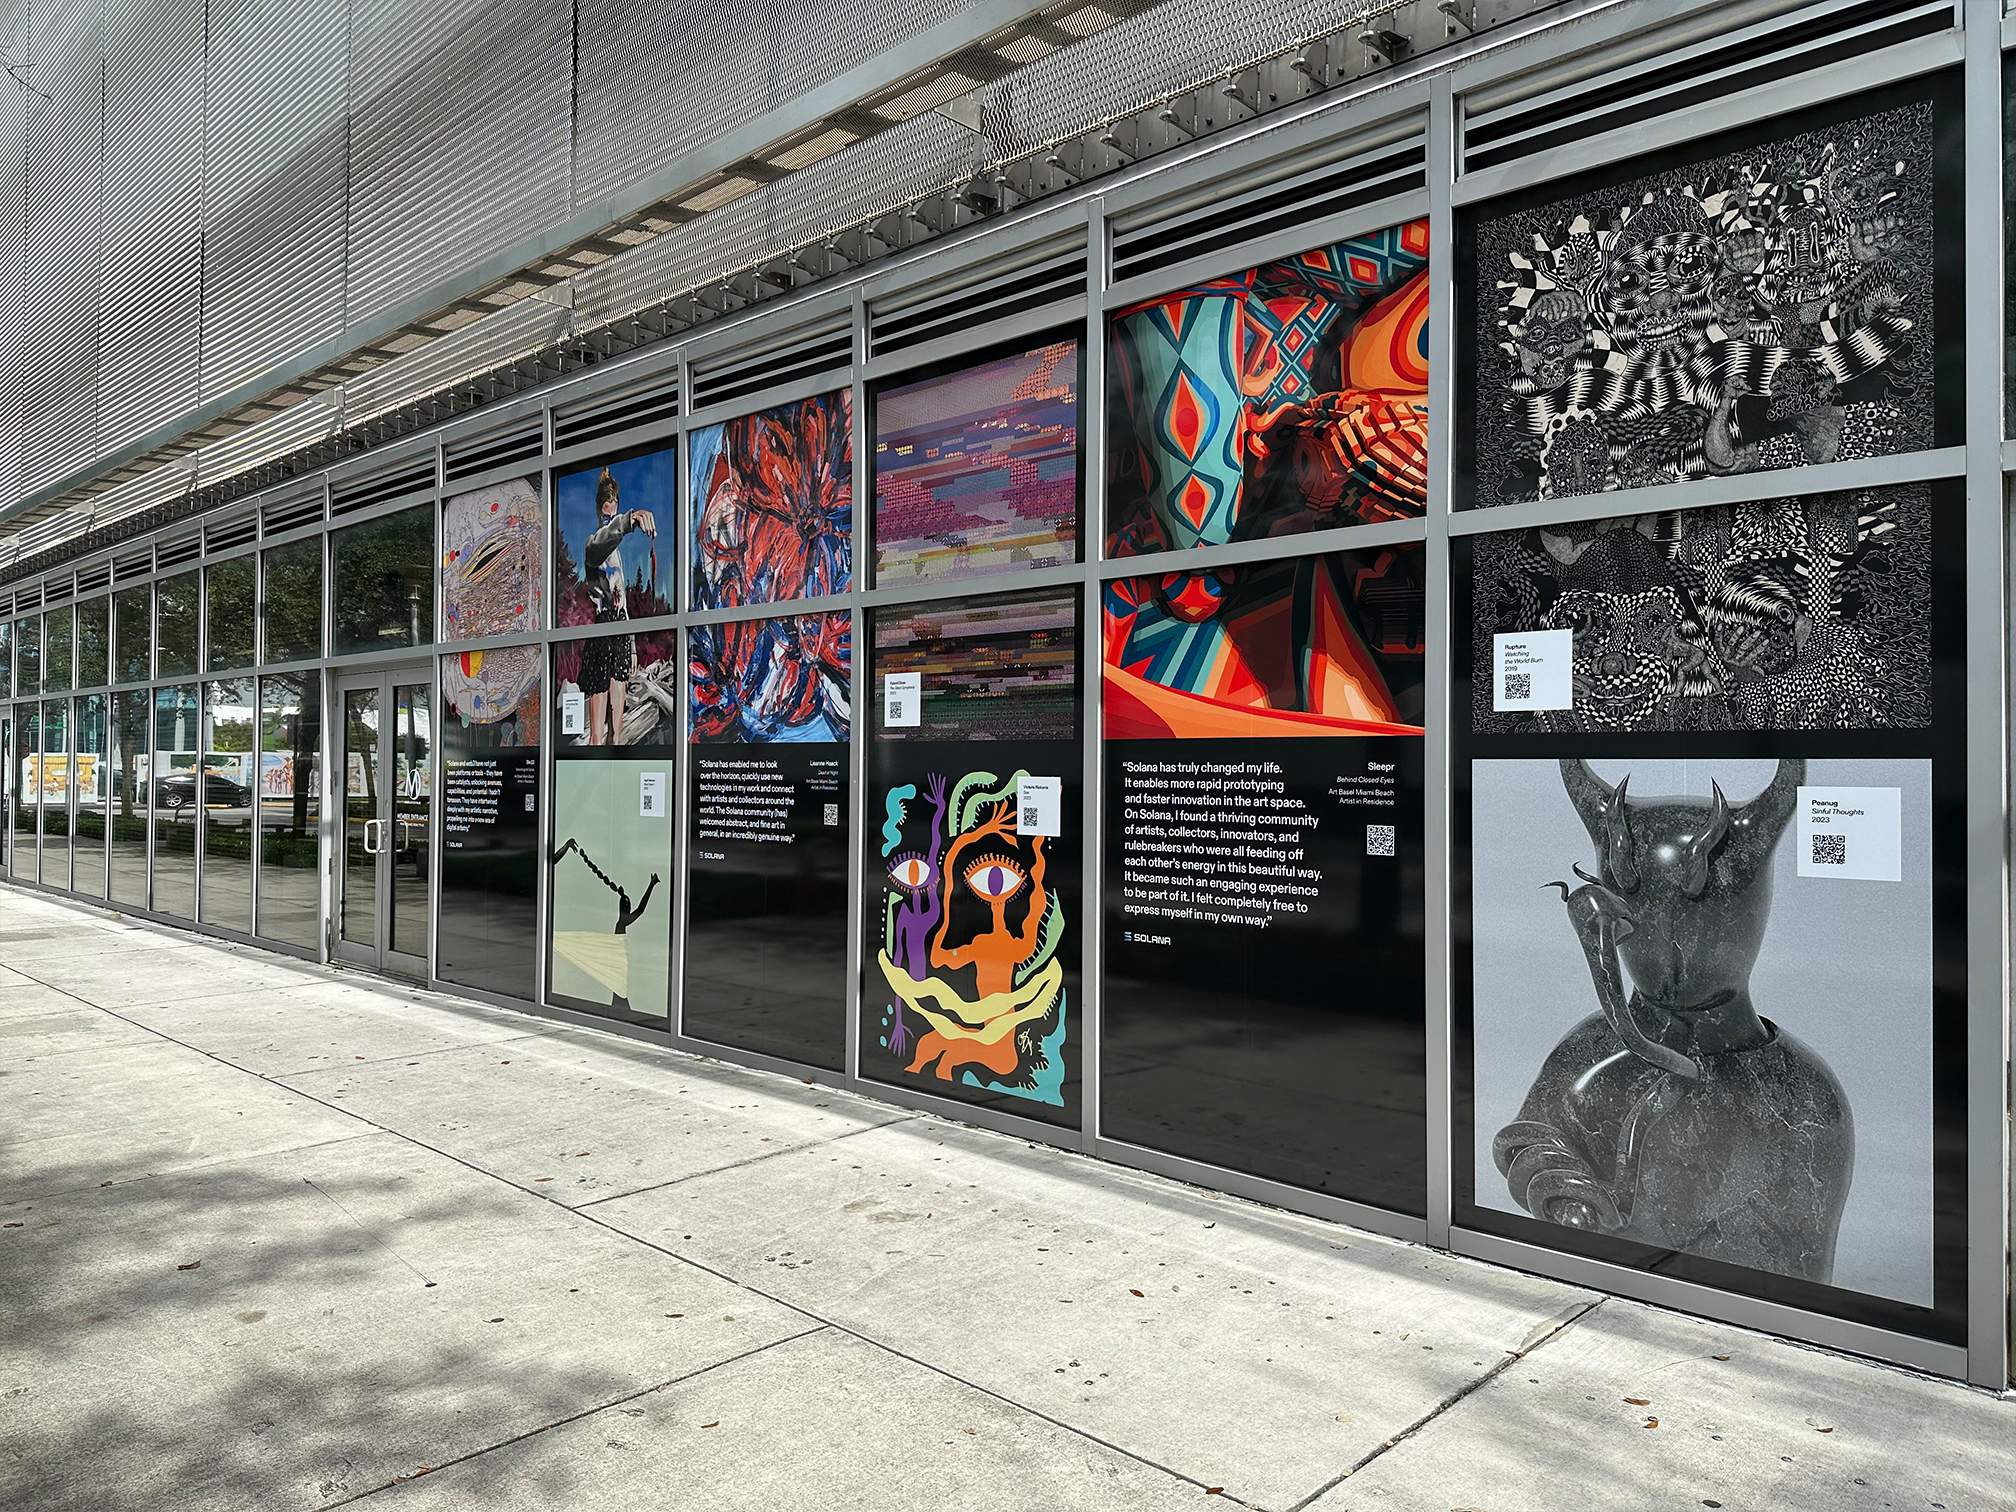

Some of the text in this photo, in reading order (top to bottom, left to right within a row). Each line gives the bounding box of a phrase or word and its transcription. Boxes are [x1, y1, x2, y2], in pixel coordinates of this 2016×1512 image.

[766, 760, 778, 768] look
[1160, 762, 1176, 772] has
[1177, 762, 1200, 775] truly
[1201, 762, 1244, 775] changed
[1247, 765, 1262, 776] my
[1264, 762, 1282, 773] life.
[1368, 762, 1395, 772] Sleepr
[721, 772, 741, 781] horizon,
[741, 772, 760, 782] quickly
[700, 783, 732, 793] technologies
[760, 784, 771, 792] and
[1125, 777, 1284, 793] It enables more rapid prototyping
[712, 795, 728, 803] artists
[739, 796, 764, 804] collectors
[765, 797, 784, 805] around
[785, 797, 794, 805] the
[1125, 793, 1306, 810] and faster innovation in the art space.
[715, 806, 725, 814] The
[726, 806, 743, 815] Solana
[744, 808, 774, 818] community
[774, 808, 788, 818] (has)
[1125, 808, 1319, 829] On Solana, I found a thriving community
[1832, 808, 1865, 817] Thoughts
[699, 817, 726, 826] welcomed
[726, 818, 749, 828] abstract,
[760, 820, 770, 828] fine
[780, 821, 785, 829] in
[699, 830, 719, 838] general,
[732, 830, 758, 842] incredibly
[758, 833, 780, 842] genuine
[1125, 824, 1299, 844] of artists, collectors, innovators, and
[1125, 840, 1304, 862] rulebreakers who were all feeding off
[1125, 856, 1146, 866] each
[1182, 861, 1216, 874] energy
[1217, 861, 1226, 872] in
[1227, 862, 1246, 873] this
[1249, 863, 1295, 877] beautiful
[1297, 869, 1322, 880] way.
[1125, 871, 1318, 896] It became such an engaging experience
[1124, 887, 1308, 913] to be part of it. I felt completely free to
[1124, 904, 1160, 916] express
[1162, 908, 1193, 919] myself
[1194, 908, 1203, 919] in
[1205, 912, 1220, 924] my
[1221, 914, 1243, 924] own
[1134, 934, 1171, 945] SOLANA
